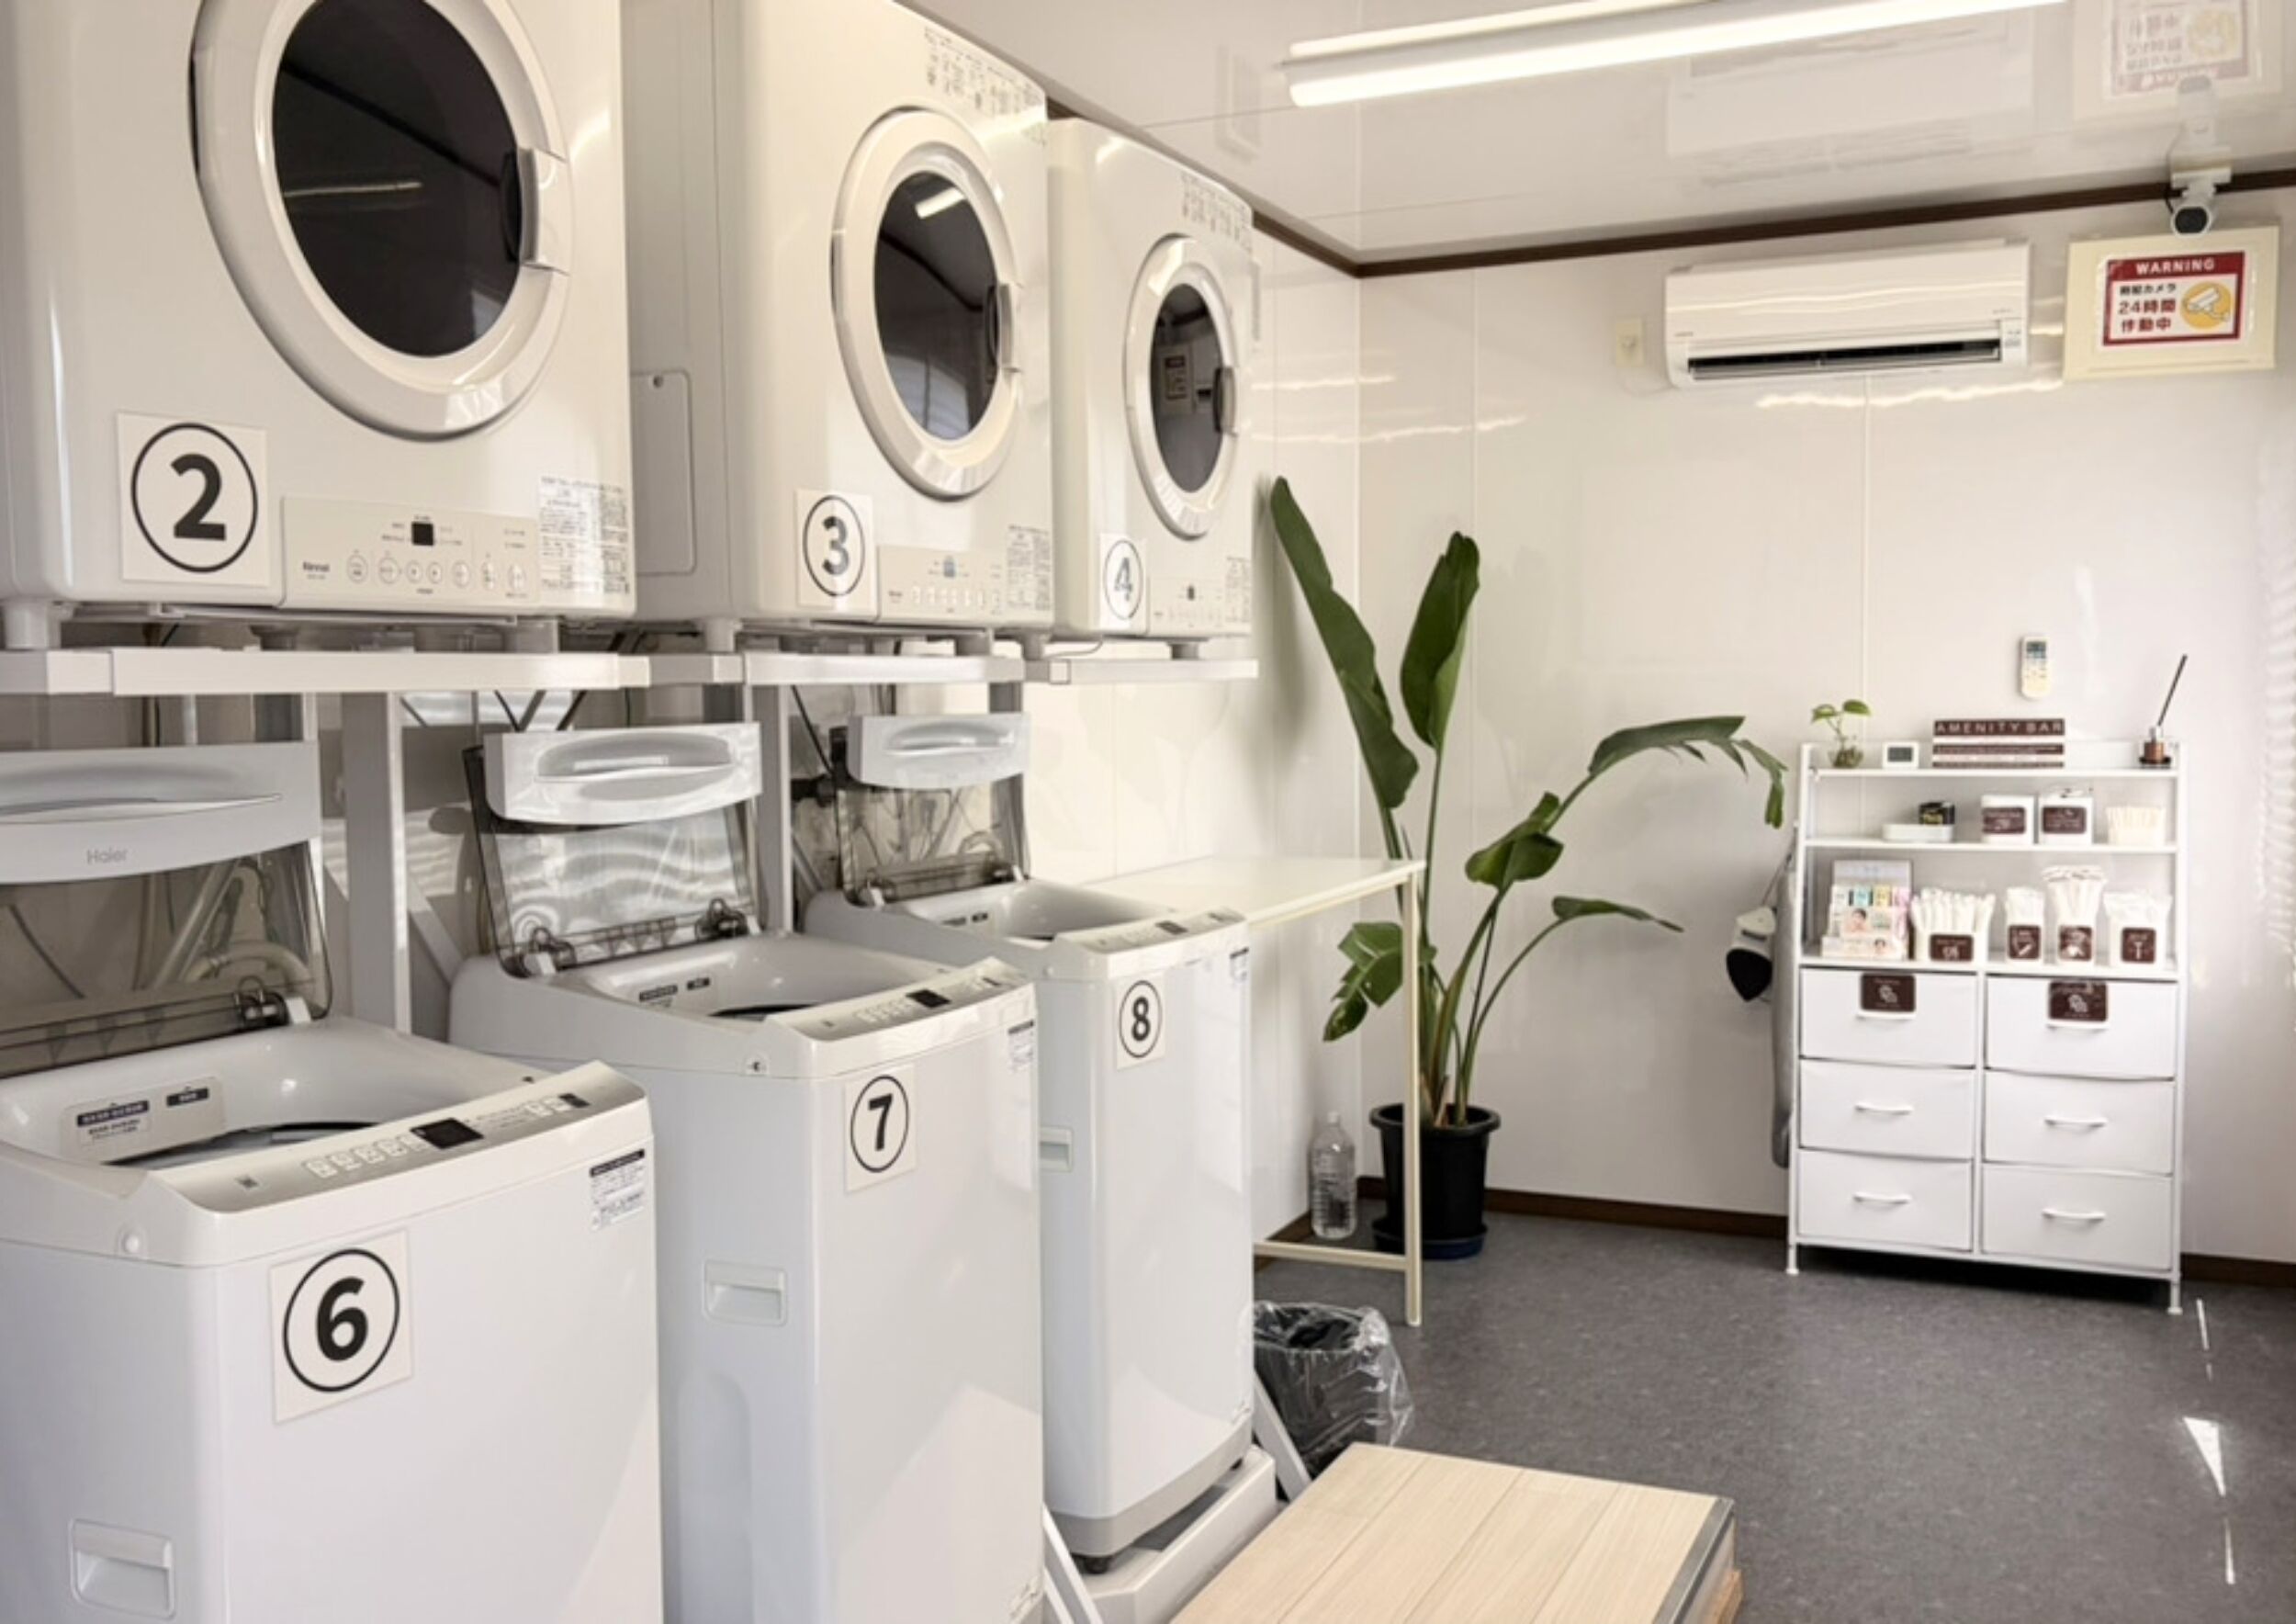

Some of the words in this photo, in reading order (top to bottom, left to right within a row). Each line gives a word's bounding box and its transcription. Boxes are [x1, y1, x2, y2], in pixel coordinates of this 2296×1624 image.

[2136, 257, 2215, 275] WARNING
[2118, 299, 2177, 315] 24時間
[170, 452, 227, 541] 2
[821, 516, 850, 575] 3
[1114, 557, 1133, 602] 4
[1937, 722, 2020, 733] AMENITY
[2026, 722, 2062, 732] BAR
[87, 847, 128, 864] Haier
[1131, 996, 1151, 1042] 8
[868, 1093, 893, 1151] 7
[317, 1276, 367, 1361] 6
